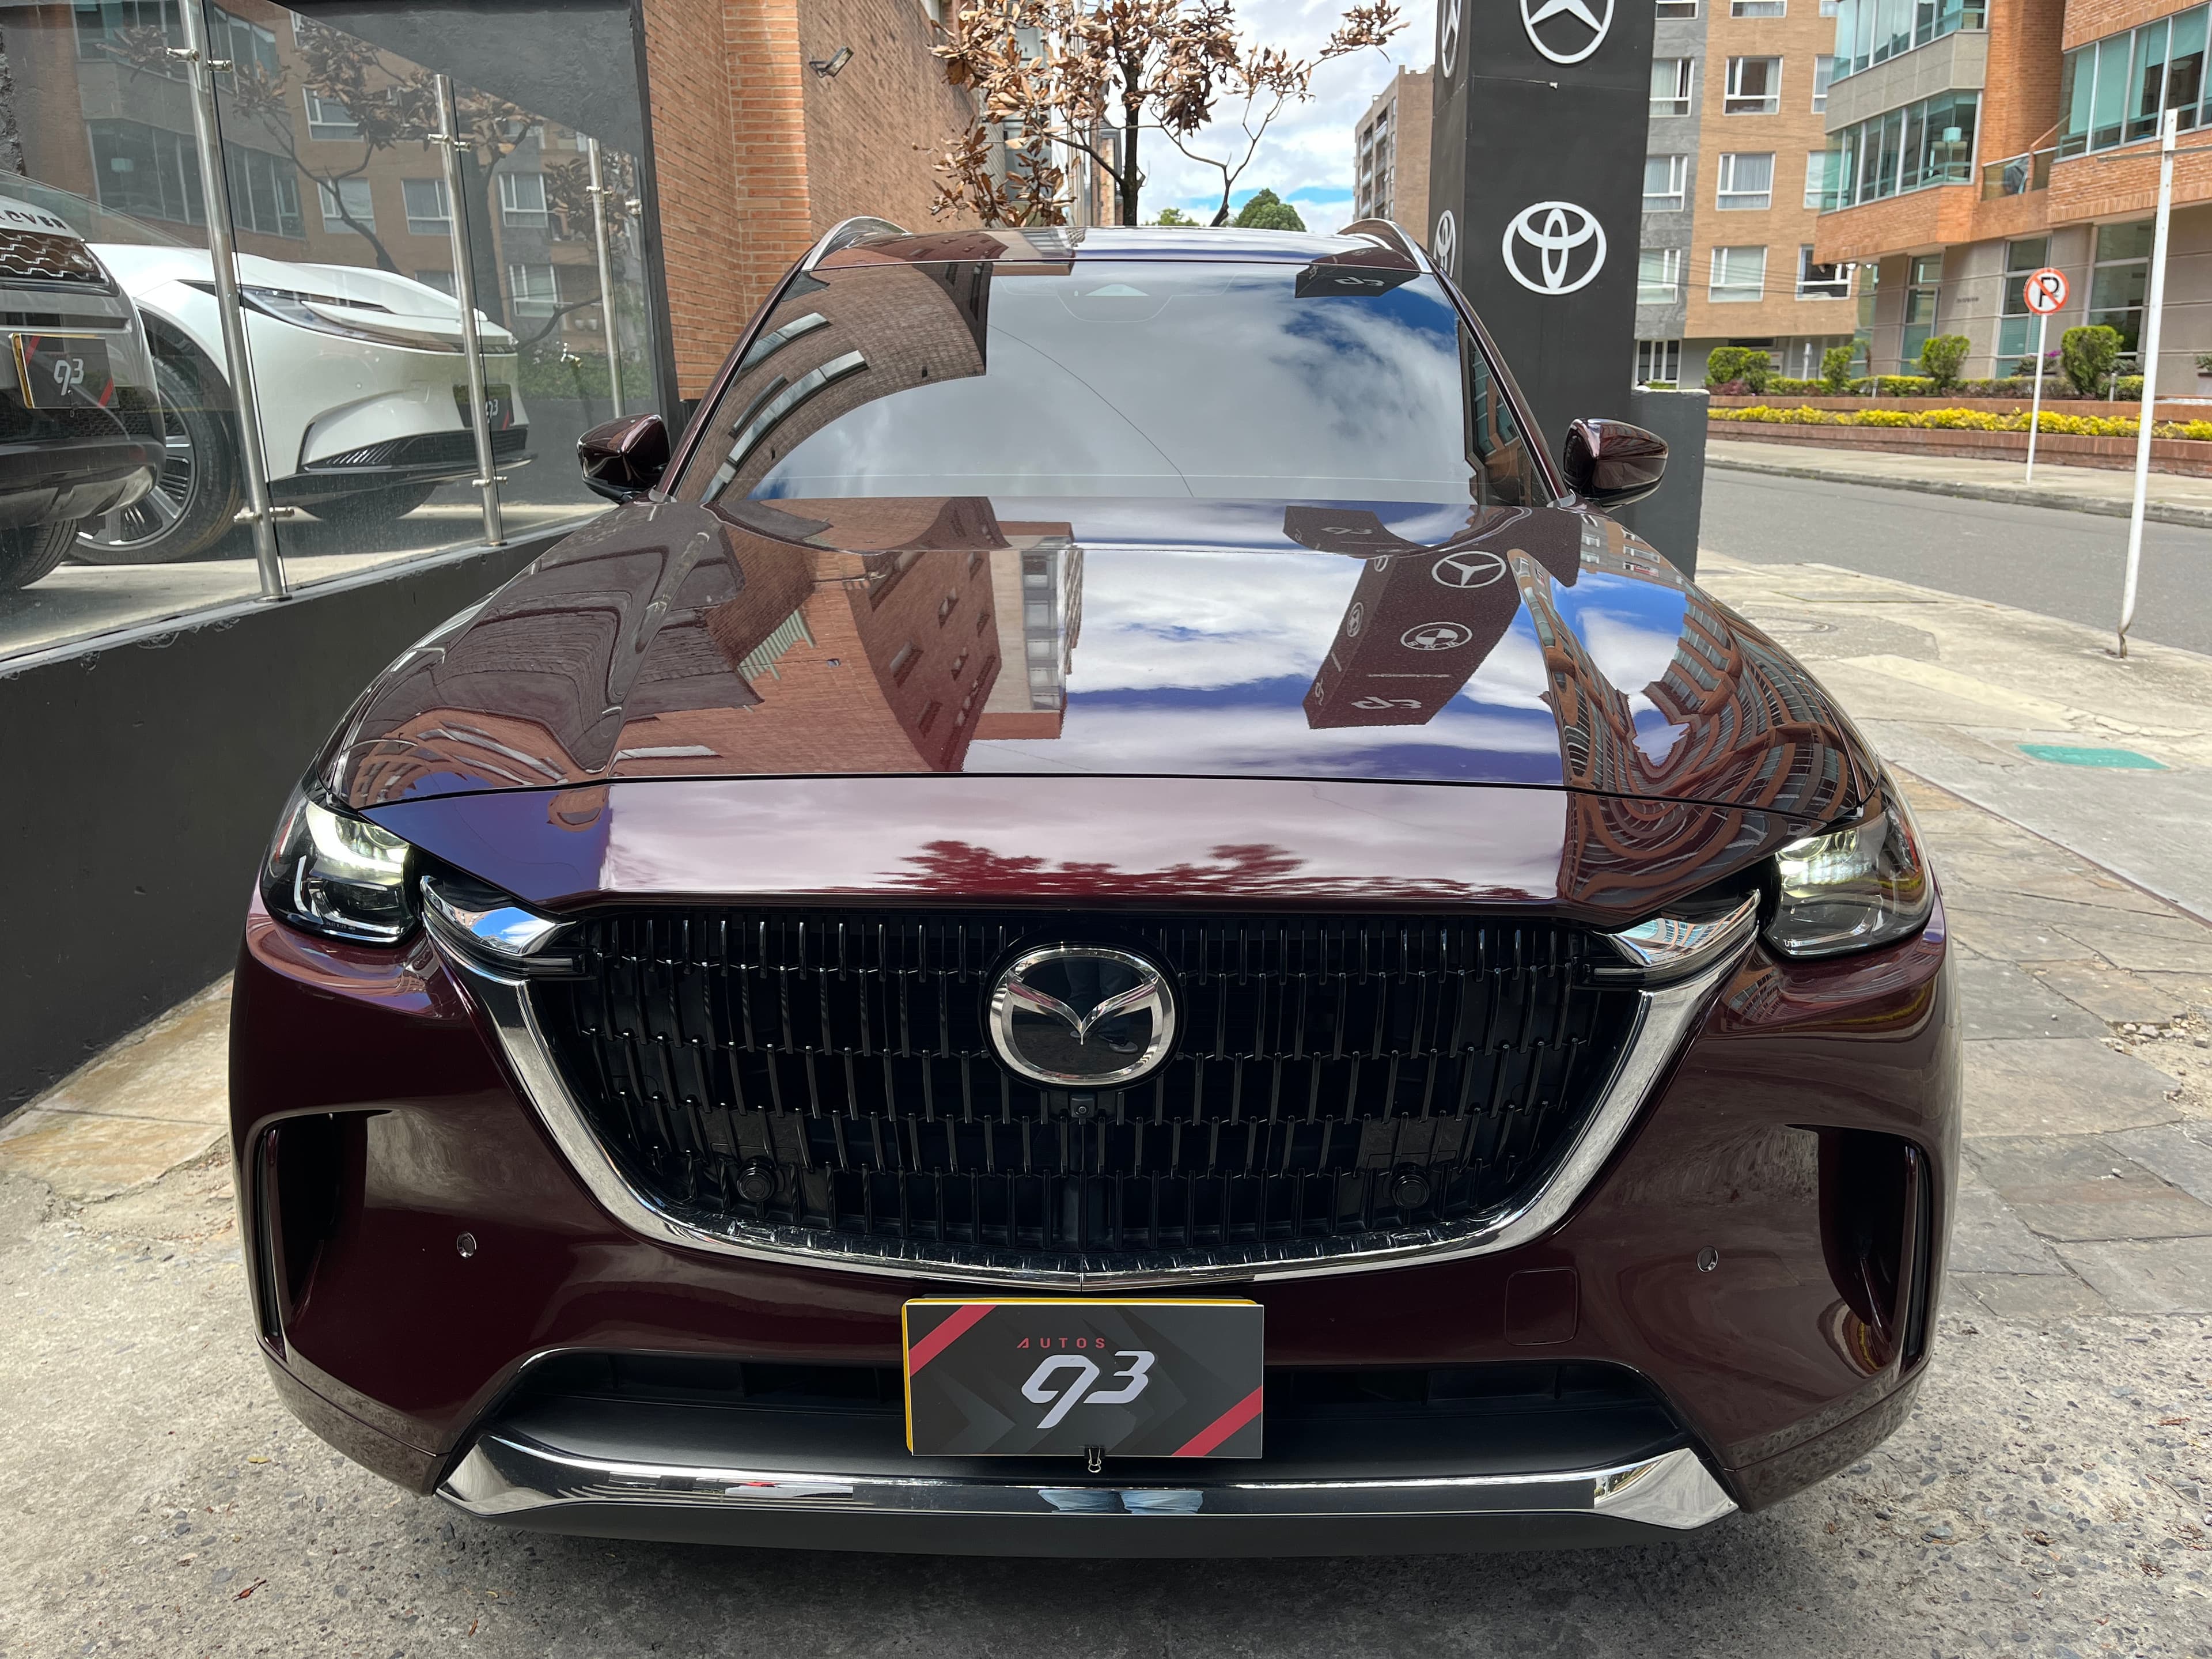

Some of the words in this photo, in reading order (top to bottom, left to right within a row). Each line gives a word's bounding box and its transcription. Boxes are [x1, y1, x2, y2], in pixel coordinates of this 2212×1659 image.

[2039, 277, 2059, 307] P
[54, 358, 85, 396] 93
[1016, 1338, 1105, 1349] AUTOS
[1021, 1351, 1155, 1429] 93
